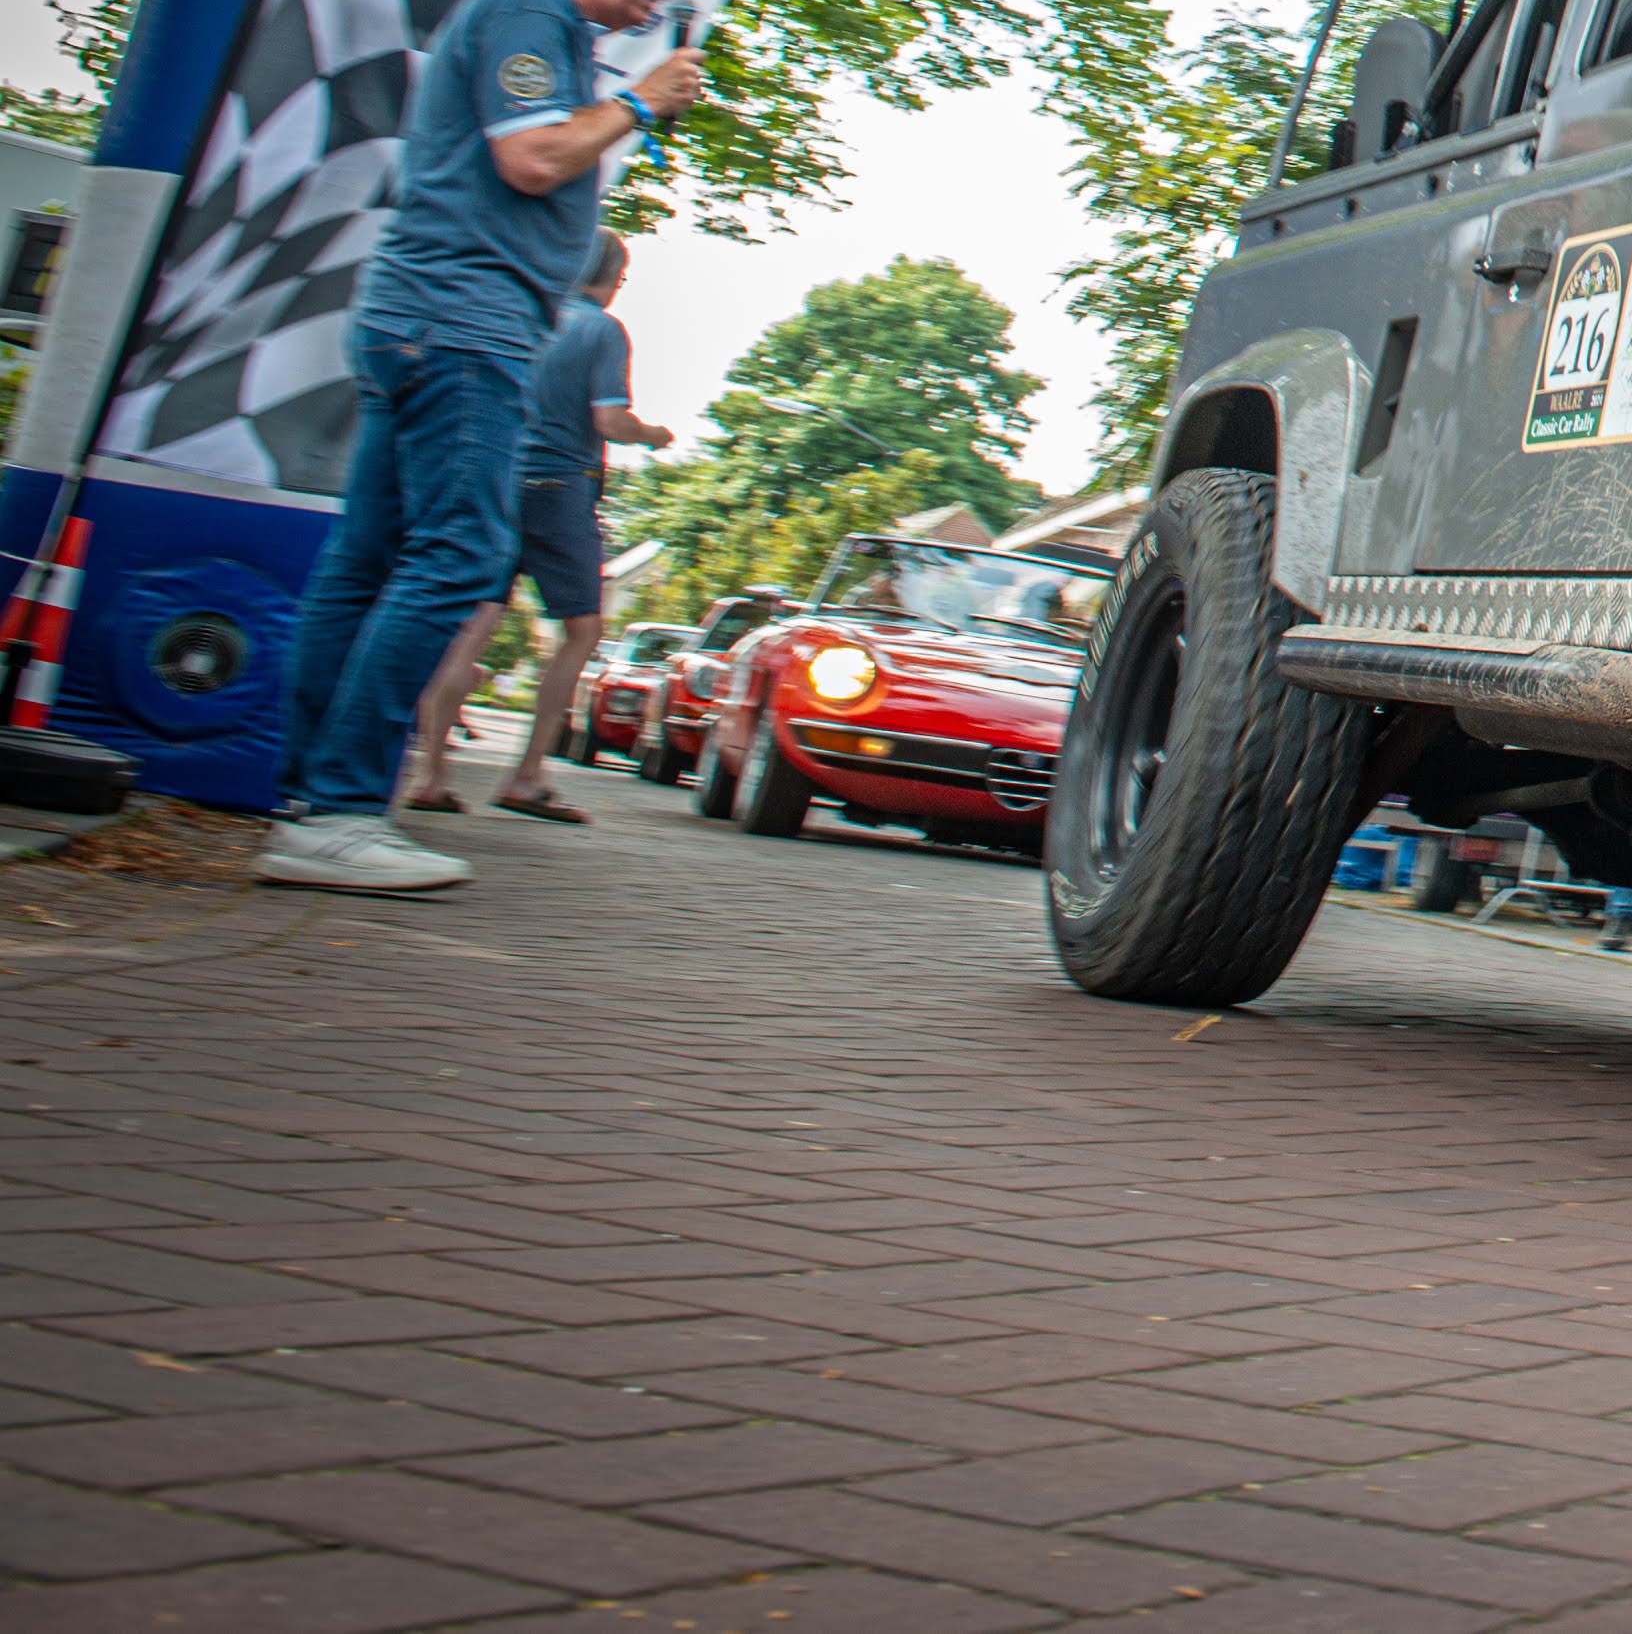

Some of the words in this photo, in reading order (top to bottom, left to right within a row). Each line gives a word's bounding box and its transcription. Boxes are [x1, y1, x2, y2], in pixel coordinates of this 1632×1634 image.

[1549, 307, 1610, 377] 216
[1550, 389, 1584, 412] WAALRE
[1531, 417, 1558, 438] Classic
[1558, 415, 1573, 435] Car
[1573, 412, 1595, 437] Rally
